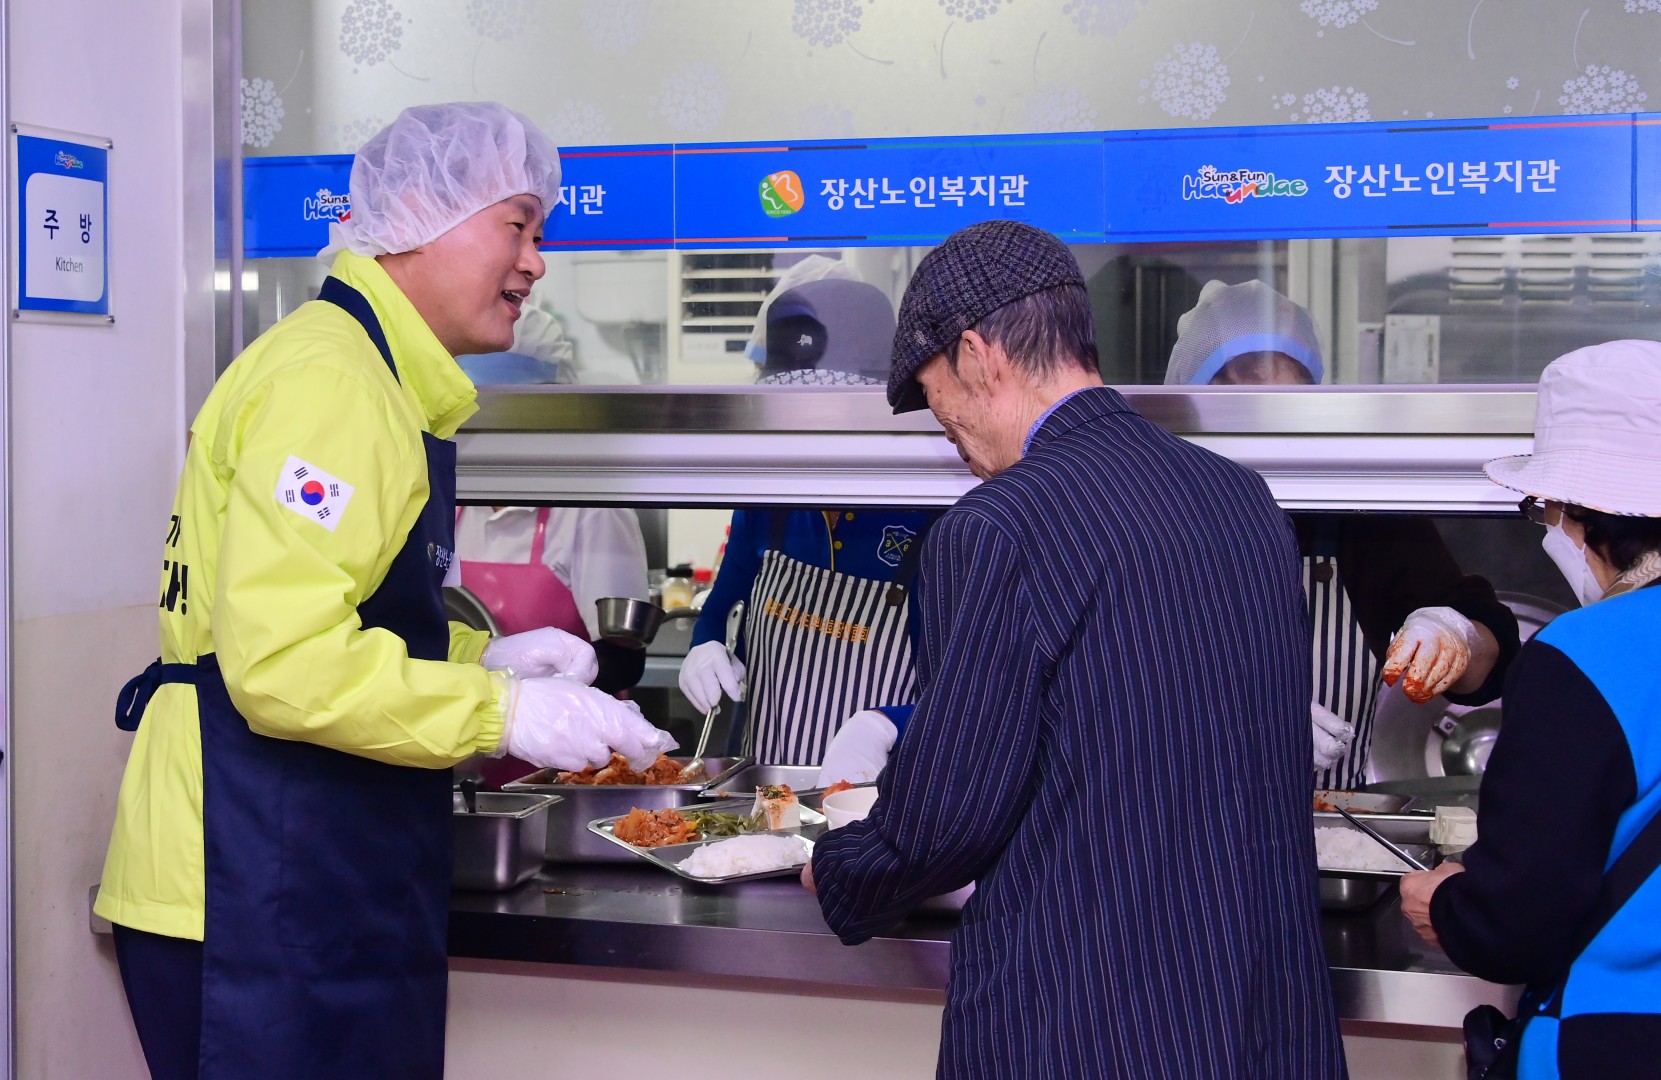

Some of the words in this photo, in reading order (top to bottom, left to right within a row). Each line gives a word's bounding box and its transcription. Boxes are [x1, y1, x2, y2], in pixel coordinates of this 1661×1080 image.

[1183, 173, 1308, 204] Haeundae
[1203, 170, 1265, 182] Sun&Fun
[1324, 159, 1561, 199] 장산노인복지관
[819, 174, 1029, 211] 장산노인복지관
[55, 256, 84, 273] Kitchen
